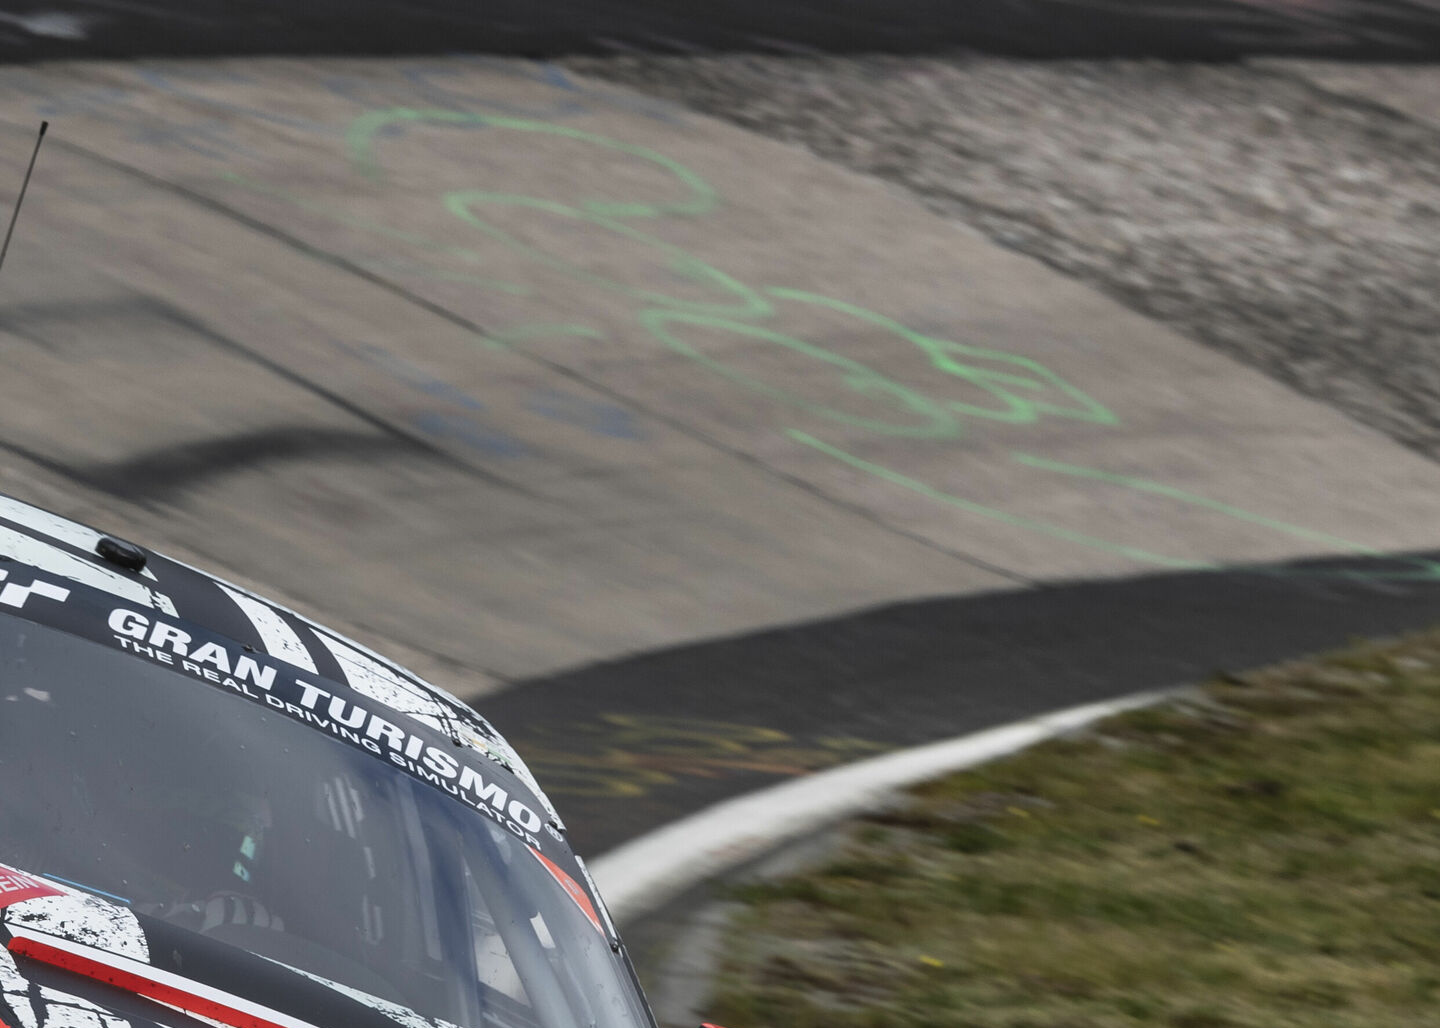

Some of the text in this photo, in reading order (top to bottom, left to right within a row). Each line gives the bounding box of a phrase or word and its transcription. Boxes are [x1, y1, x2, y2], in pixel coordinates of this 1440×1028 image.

[108, 608, 542, 833] GRAN TURISMO
[113, 634, 542, 850] THE REAL DRIVING SIMULATOR
